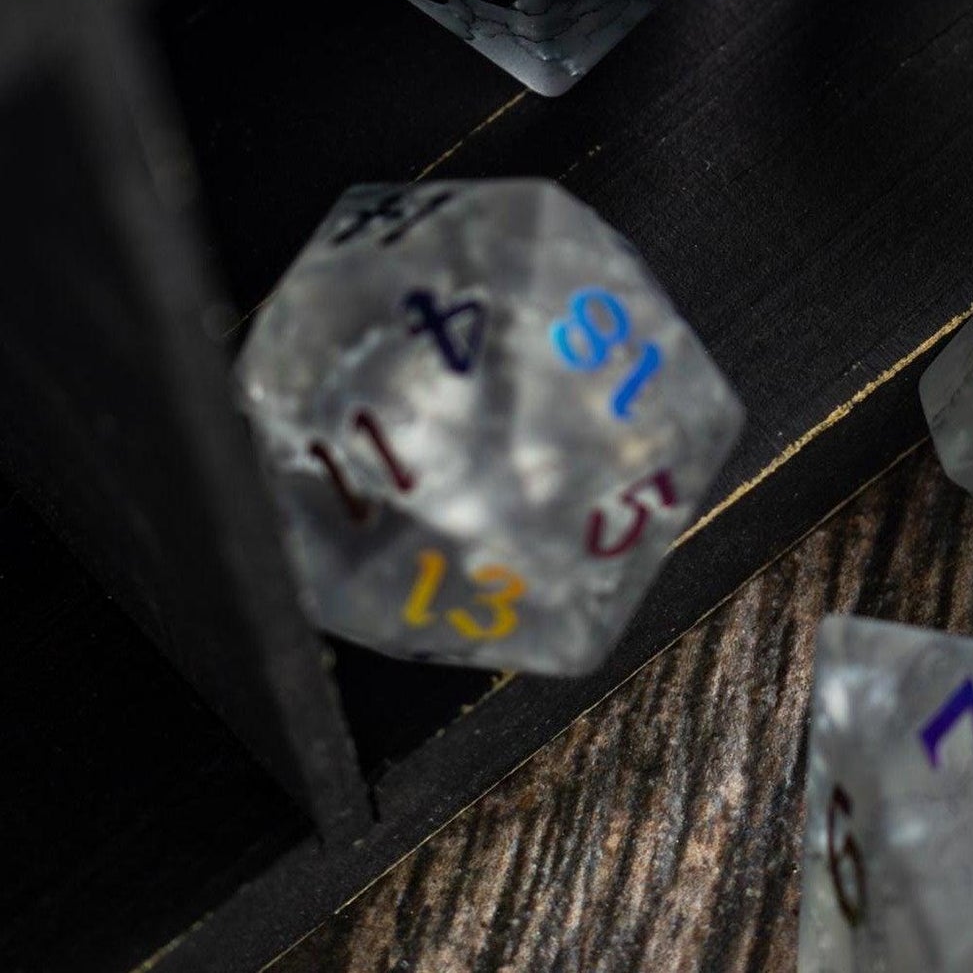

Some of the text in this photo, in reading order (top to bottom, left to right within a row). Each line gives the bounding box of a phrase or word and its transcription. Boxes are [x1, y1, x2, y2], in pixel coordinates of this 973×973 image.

[401, 285, 489, 376] 4
[310, 408, 416, 523] 11
[584, 469, 677, 561] 5
[402, 548, 527, 641] 13
